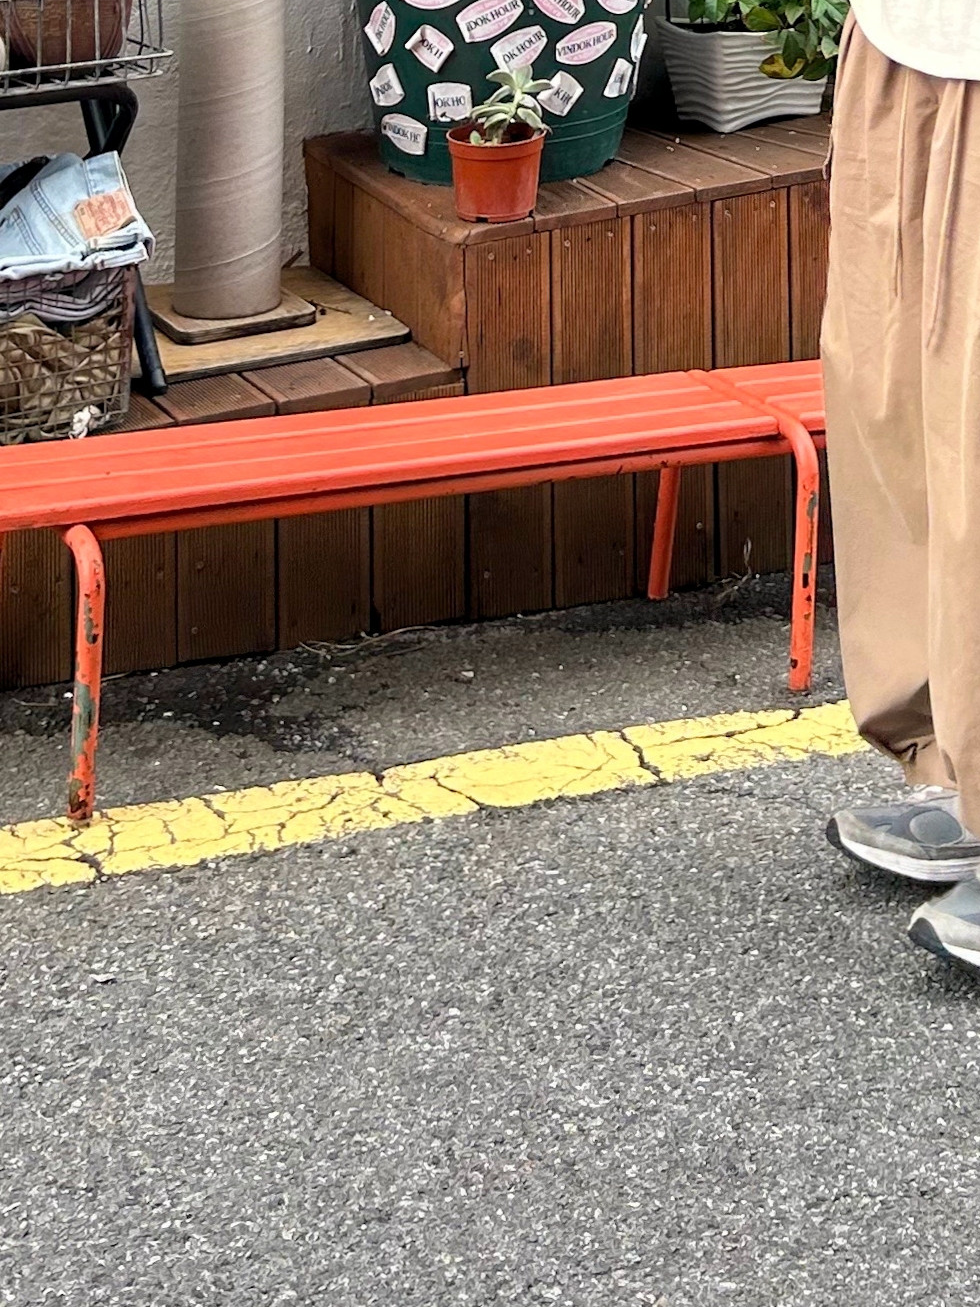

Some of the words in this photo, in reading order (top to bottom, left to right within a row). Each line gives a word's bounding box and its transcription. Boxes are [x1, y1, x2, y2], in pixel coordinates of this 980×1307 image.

[490, 0, 521, 20] HOUR
[516, 30, 545, 54] HOUR
[557, 40, 592, 58] VINDOK
[591, 29, 615, 47] HOUR
